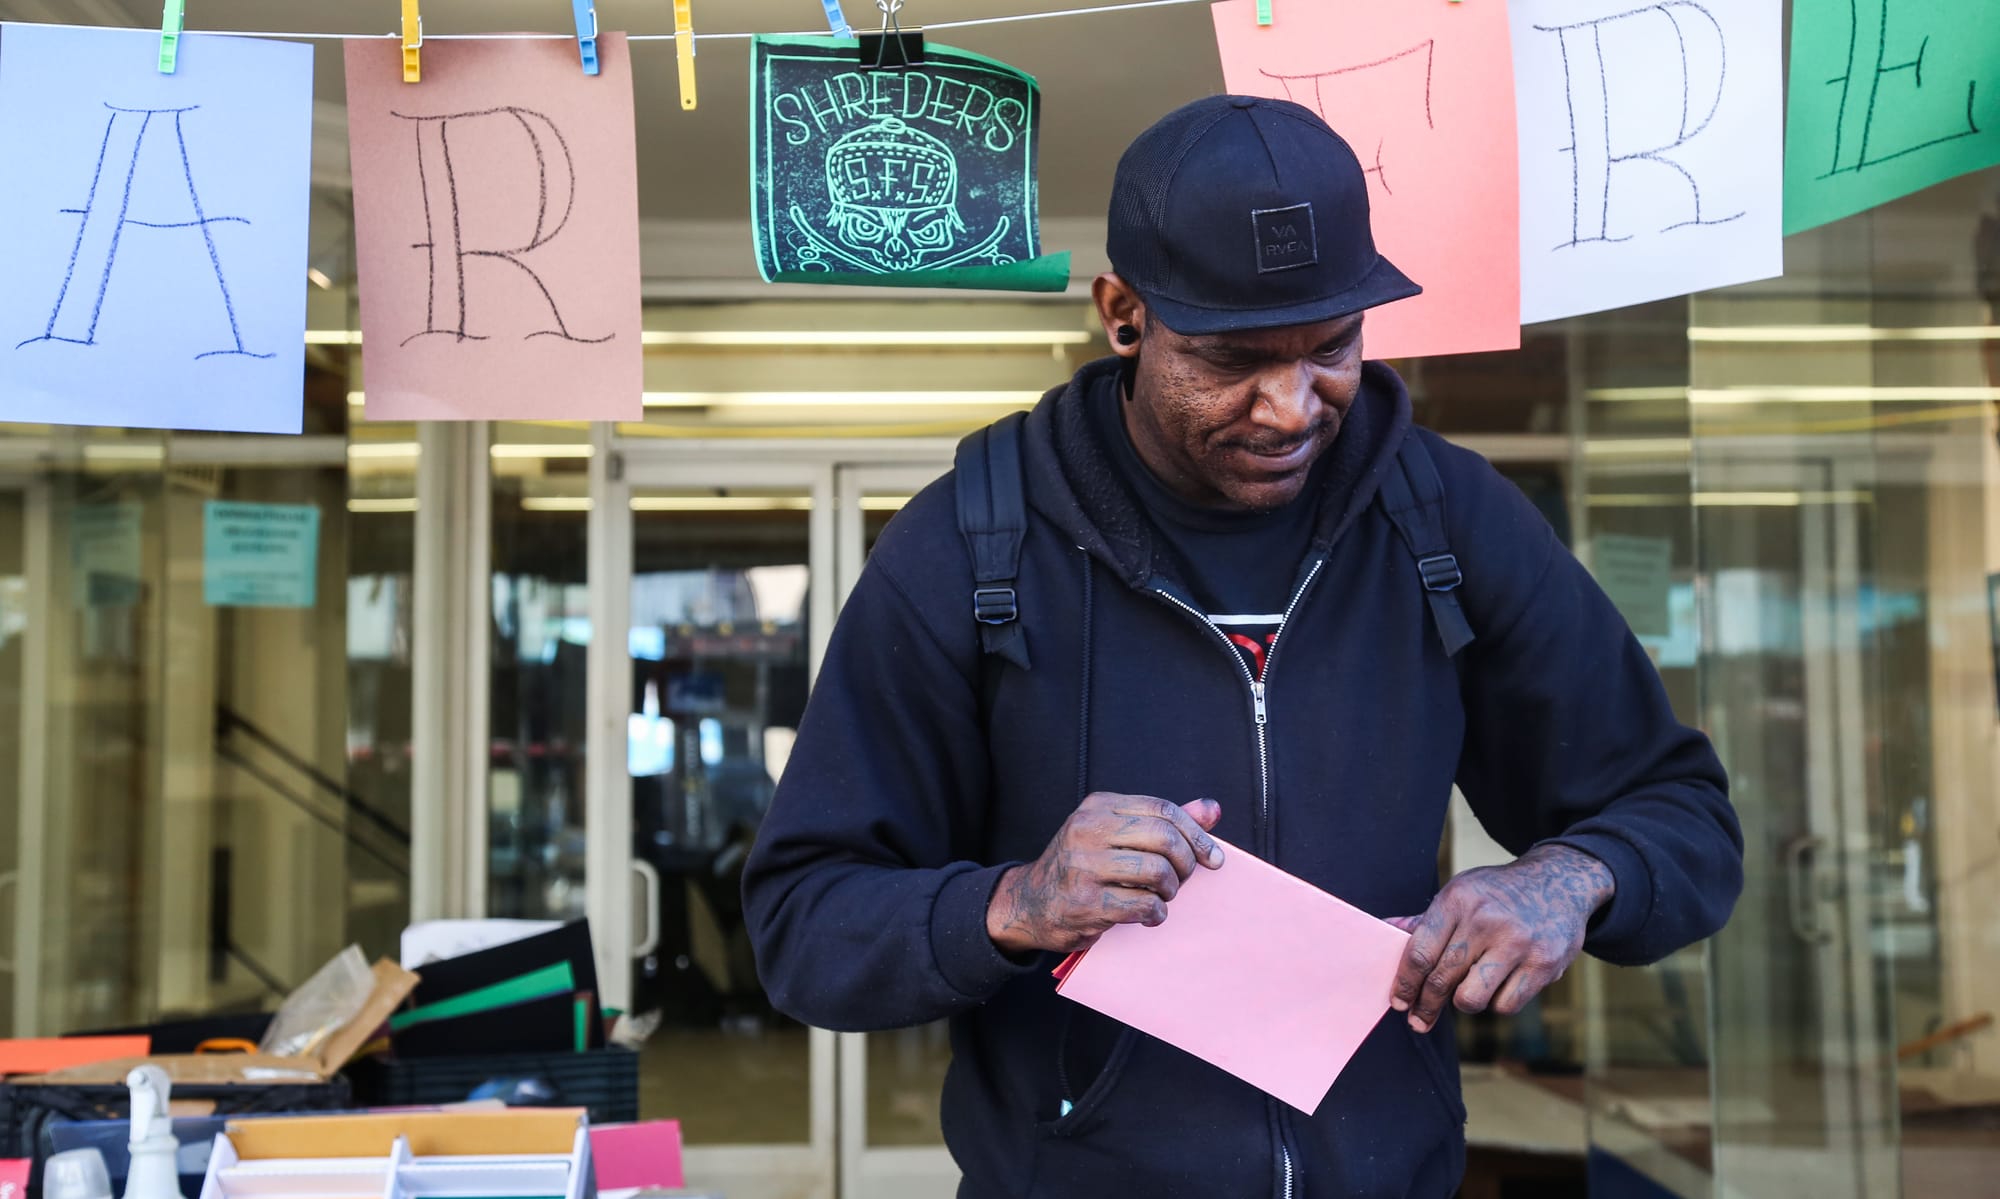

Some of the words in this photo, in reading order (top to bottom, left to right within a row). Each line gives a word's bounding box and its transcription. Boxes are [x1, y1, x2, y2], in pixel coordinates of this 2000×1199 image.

[15, 102, 277, 361] A
[390, 105, 616, 344] R
[773, 71, 1026, 152] SHREDERS
[1532, 0, 1747, 252] R
